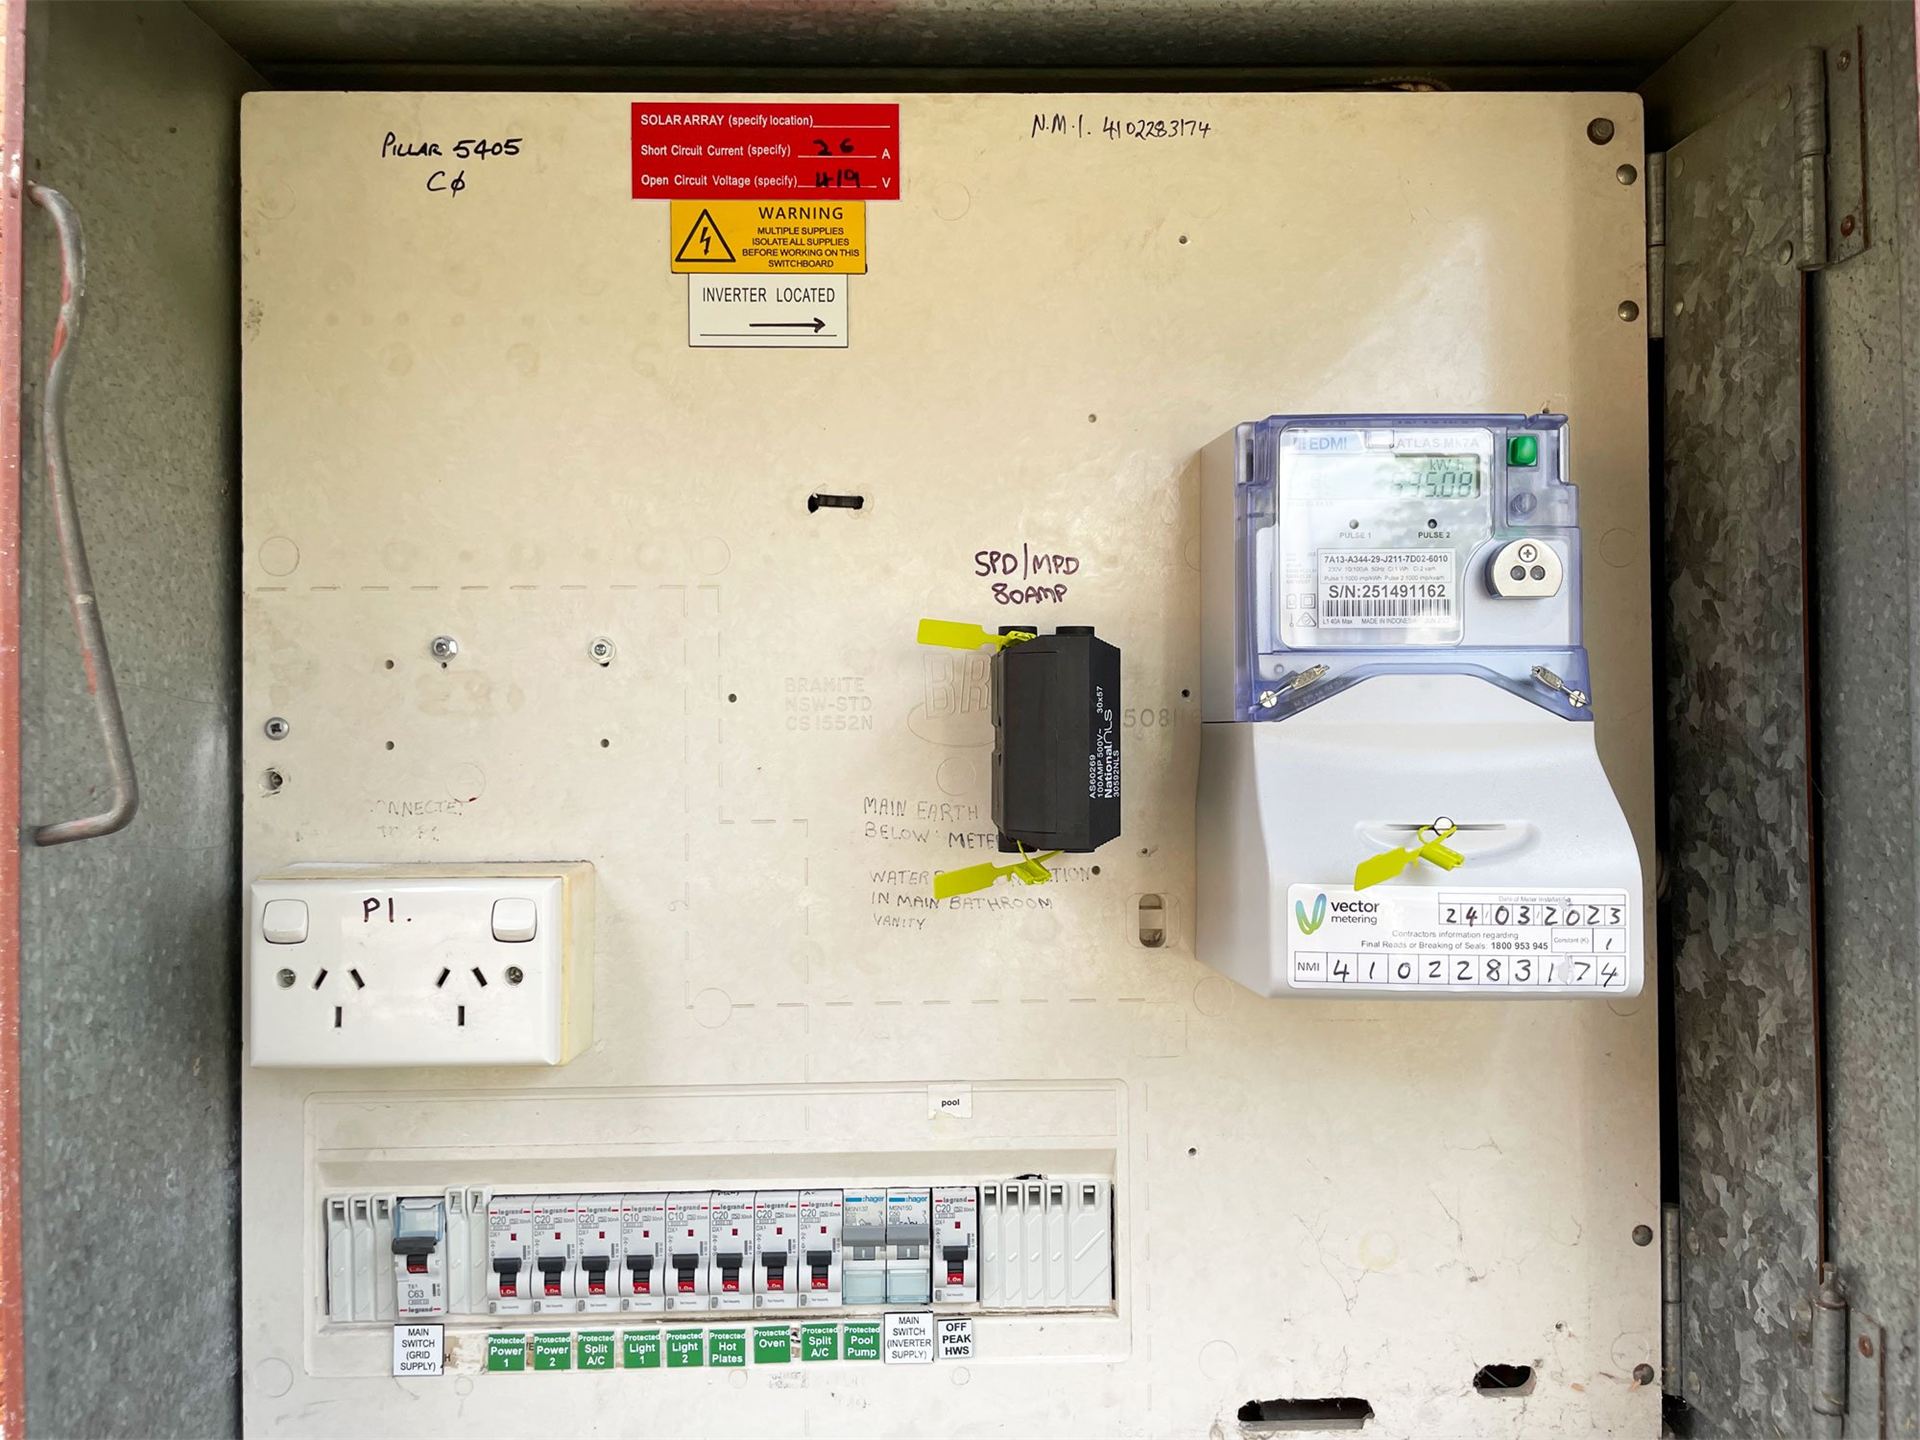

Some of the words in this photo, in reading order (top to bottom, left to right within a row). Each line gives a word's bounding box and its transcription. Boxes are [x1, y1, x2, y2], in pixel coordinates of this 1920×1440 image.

[640, 114, 682, 126] SOLAR
[684, 114, 724, 126] ARRAY
[728, 115, 767, 128] (specify
[769, 115, 813, 128] location)
[1103, 116, 1211, 140] 4102283174
[452, 138, 523, 160] 5405
[640, 144, 667, 156] Short
[671, 144, 703, 156] Circuit
[707, 144, 744, 156] Current
[747, 144, 791, 157] (specify)
[881, 149, 891, 160] A
[641, 175, 669, 187] Open
[674, 174, 708, 186] Circuit
[712, 175, 750, 187] Voltage
[754, 175, 798, 187] (specify)
[881, 177, 891, 188] V
[758, 206, 844, 220] WARNING
[757, 227, 800, 235] MULTIPLE
[801, 227, 844, 235] SUPPLIES
[752, 238, 789, 246] ISOLATE
[789, 238, 805, 246] ALL
[806, 238, 850, 246] SUPPLIES
[742, 249, 778, 257] BEFORE
[780, 249, 824, 257] WORKING
[825, 249, 838, 257] ON
[839, 249, 860, 257] THIS
[768, 260, 834, 268] SWITCHBOARD
[702, 287, 767, 302] INVERTER
[776, 288, 835, 303] LOCATED
[1339, 531, 1365, 539] PULSE
[1418, 531, 1445, 539] PULSE
[1446, 531, 1451, 539] 2
[1328, 584, 1446, 599] S/N:251491162
[1104, 744, 1112, 798] National
[863, 796, 907, 817] MAIN
[917, 800, 978, 821] EARTH
[865, 821, 929, 843] BELOW
[948, 832, 999, 849] METE
[870, 869, 929, 885] WATER
[872, 892, 889, 905] IN
[897, 893, 939, 909] MAIN
[950, 896, 1052, 911] BATHROOM
[1331, 900, 1379, 913] vector
[874, 913, 926, 930] VANITY
[1331, 914, 1377, 926] metering
[1392, 930, 1436, 938] Contractors
[1439, 931, 1481, 939] information
[1483, 931, 1519, 940] regarding
[1361, 940, 1380, 948] Final
[1419, 941, 1453, 950] Breaking
[1491, 942, 1512, 950] 1800
[1514, 942, 1530, 950] 953
[1532, 942, 1549, 950] 945
[1297, 962, 1320, 972] NMI
[941, 1098, 960, 1108] pool
[865, 1195, 885, 1203] hager
[908, 1195, 928, 1203] hager
[801, 1209, 816, 1217] C20
[935, 1204, 951, 1213] C20
[578, 1214, 595, 1223] C20
[623, 1213, 639, 1222] C10
[668, 1212, 684, 1221] C10
[712, 1211, 728, 1220] C20
[756, 1210, 772, 1219] C20
[490, 1216, 506, 1225] C20
[534, 1215, 550, 1224] C20
[408, 1289, 424, 1299] C63
[899, 1316, 920, 1324] MAIN
[844, 1326, 880, 1334] Protected
[945, 1322, 967, 1331] OFF
[709, 1332, 746, 1340] Protected
[754, 1329, 790, 1337] Protected
[893, 1328, 926, 1336] SWITCH
[488, 1336, 525, 1344] Protected
[578, 1334, 615, 1342] Protected
[624, 1333, 661, 1341] Protected
[808, 1336, 832, 1346] Split
[850, 1336, 873, 1345] Pool
[942, 1334, 972, 1344] PEAK
[402, 1339, 435, 1347] SWITCH
[672, 1342, 698, 1353] Light
[719, 1342, 737, 1351] Hot
[759, 1339, 785, 1348] Oven
[887, 1339, 932, 1349] (INVERTER
[490, 1347, 523, 1355] Power
[536, 1346, 568, 1355] Power
[584, 1344, 608, 1355] Split
[629, 1343, 656, 1354] Light
[811, 1348, 829, 1357] A/C
[944, 1346, 970, 1356] HWS
[406, 1350, 430, 1359] (GRID
[847, 1348, 877, 1359] Pump
[892, 1350, 927, 1359] SUPPLY)
[504, 1359, 509, 1367] 1
[549, 1358, 556, 1367] 2
[587, 1356, 605, 1365] A/C
[640, 1356, 644, 1364] 1
[682, 1354, 688, 1363] 2
[712, 1354, 743, 1363] Plates
[400, 1362, 436, 1372] SUPPLY)
